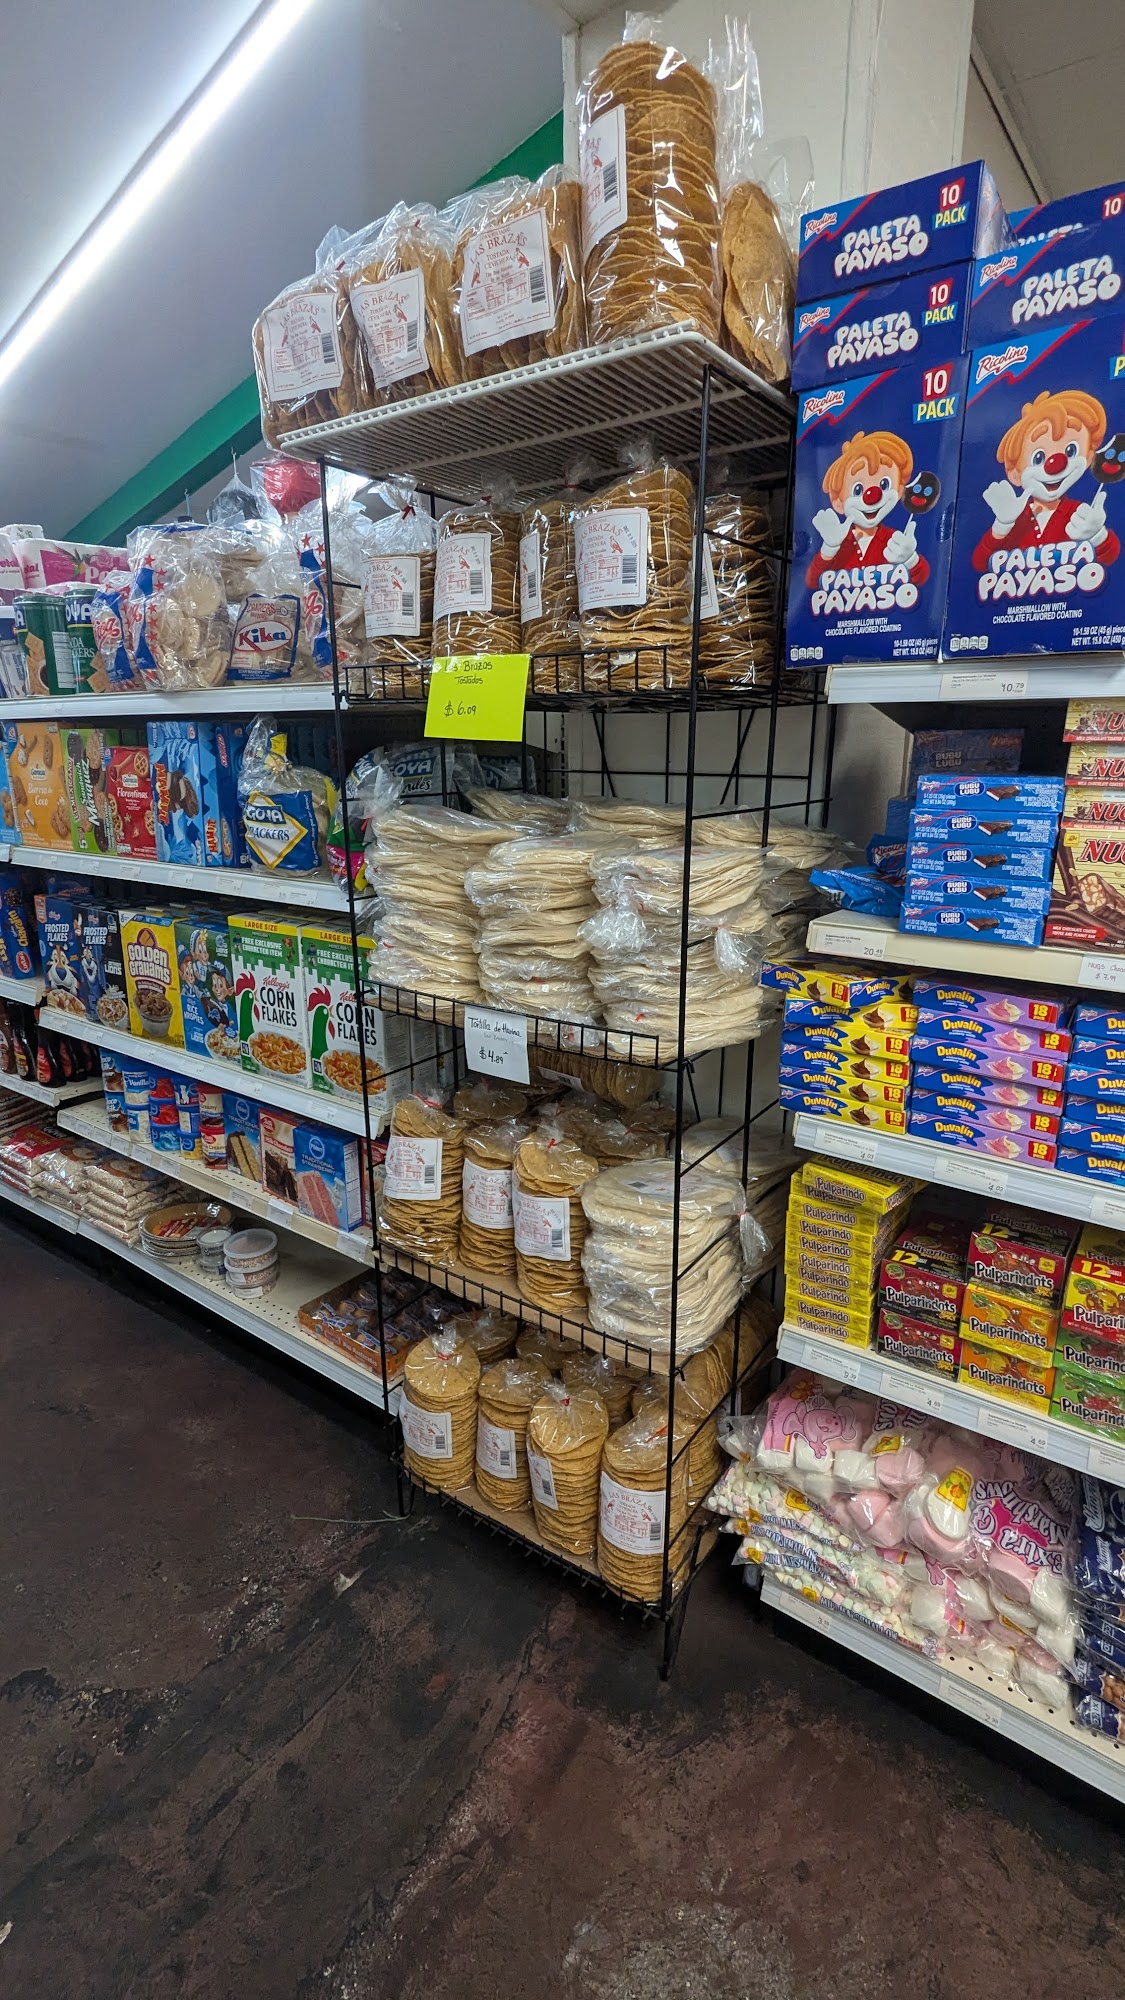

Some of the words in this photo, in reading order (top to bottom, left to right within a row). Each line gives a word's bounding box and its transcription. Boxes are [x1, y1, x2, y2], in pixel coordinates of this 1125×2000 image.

[941, 184, 960, 206] 10
[1103, 197, 1122, 217] 10
[935, 206, 966, 228] PACK
[843, 214, 921, 252] PALETA
[470, 243, 485, 265] LAS
[487, 232, 528, 250] BRAZAS
[834, 232, 929, 277] PAYASO
[1022, 254, 1113, 298] PALETA
[372, 291, 407, 307] BRAZAS
[930, 284, 949, 306] 10
[1011, 273, 1122, 326] PAYASO
[924, 306, 955, 325] PACK
[836, 311, 912, 347] PALETA
[827, 328, 919, 369] PAYASO
[976, 346, 1028, 385] Ricolino
[924, 370, 948, 395] 10
[803, 390, 845, 422] Ricolino
[917, 397, 955, 421] PACK
[588, 523, 623, 537] BRAZAS
[989, 541, 1096, 573] PALETA
[821, 563, 909, 591] PALETA
[978, 563, 1105, 602] PAYASO
[811, 583, 918, 616] PAYASO
[1007, 604, 1051, 614] MARSHMALLOW
[1051, 602, 1067, 611] WITH
[837, 618, 875, 627] MARSHMALLOW
[875, 617, 888, 625] WITH
[992, 613, 1025, 624] CHOCOLATE
[1026, 611, 1056, 621] FLAVORED
[1056, 609, 1083, 620] COATING
[239, 627, 287, 652] Kika
[825, 626, 854, 636] CHOCOLATE
[854, 625, 879, 634] FLAVORED
[879, 624, 901, 632] COATING
[1071, 637, 1082, 646] NET
[1102, 636, 1110, 644] OZ
[76, 762, 86, 804] Sandwich
[35, 795, 48, 806] Coco
[117, 787, 148, 799] Florentinas
[44, 923, 70, 933] FROSTED
[83, 926, 108, 937] FROSTED
[244, 921, 263, 930] LARGE
[264, 923, 278, 932] SIZE
[47, 932, 68, 942] FLAKES
[85, 935, 107, 945] FLAKES
[241, 937, 254, 945] FREE
[254, 938, 282, 950] EXCLUSIVE
[242, 943, 268, 956] CHARACTER
[269, 949, 283, 957] ITEM
[213, 960, 224, 970] POP
[317, 957, 346, 969] CHARACTER
[260, 987, 295, 1011] CORN
[833, 983, 844, 996] 18
[185, 1004, 199, 1014] RICE
[262, 1006, 297, 1027] FLAKES
[904, 1008, 918, 1019] 18
[1033, 1004, 1049, 1017] 18
[467, 1017, 491, 1031] Tortilla
[494, 1022, 501, 1032] de
[889, 1038, 903, 1049] 18
[1044, 1033, 1060, 1046] 18
[889, 1063, 903, 1073] 18
[1036, 1063, 1051, 1075] 18
[129, 1078, 149, 1086] Vanilla
[887, 1088, 901, 1098] 18
[1042, 1089, 1057, 1102] 18
[889, 1111, 902, 1121] 18
[1035, 1115, 1050, 1128] 18
[1033, 1143, 1048, 1155] 18
[301, 1160, 336, 1175] STRAWBERRY
[302, 1154, 335, 1170] TRADITIONAL
[816, 1177, 865, 1202] Pulparindo
[804, 1204, 856, 1224] Pulparindo
[801, 1220, 852, 1241] Pulparindo
[982, 1223, 1009, 1238] 12
[800, 1236, 852, 1257] Pulparindo
[800, 1253, 851, 1275] Pulparindo
[891, 1250, 920, 1265] 12
[799, 1267, 850, 1288] Pulparindo
[975, 1260, 1053, 1289] Pulparindots
[1081, 1259, 1111, 1278] 12
[800, 1282, 850, 1305] Pulparindo
[885, 1286, 956, 1314] Pulparindots
[798, 1301, 849, 1323] Pulparindo
[798, 1316, 849, 1338] Pulparindo
[969, 1316, 1046, 1348] Pulparindots
[884, 1335, 954, 1364] Pulparindots
[969, 1364, 1045, 1395] Pulparindots
[621, 1494, 652, 1511] BRAZAS
